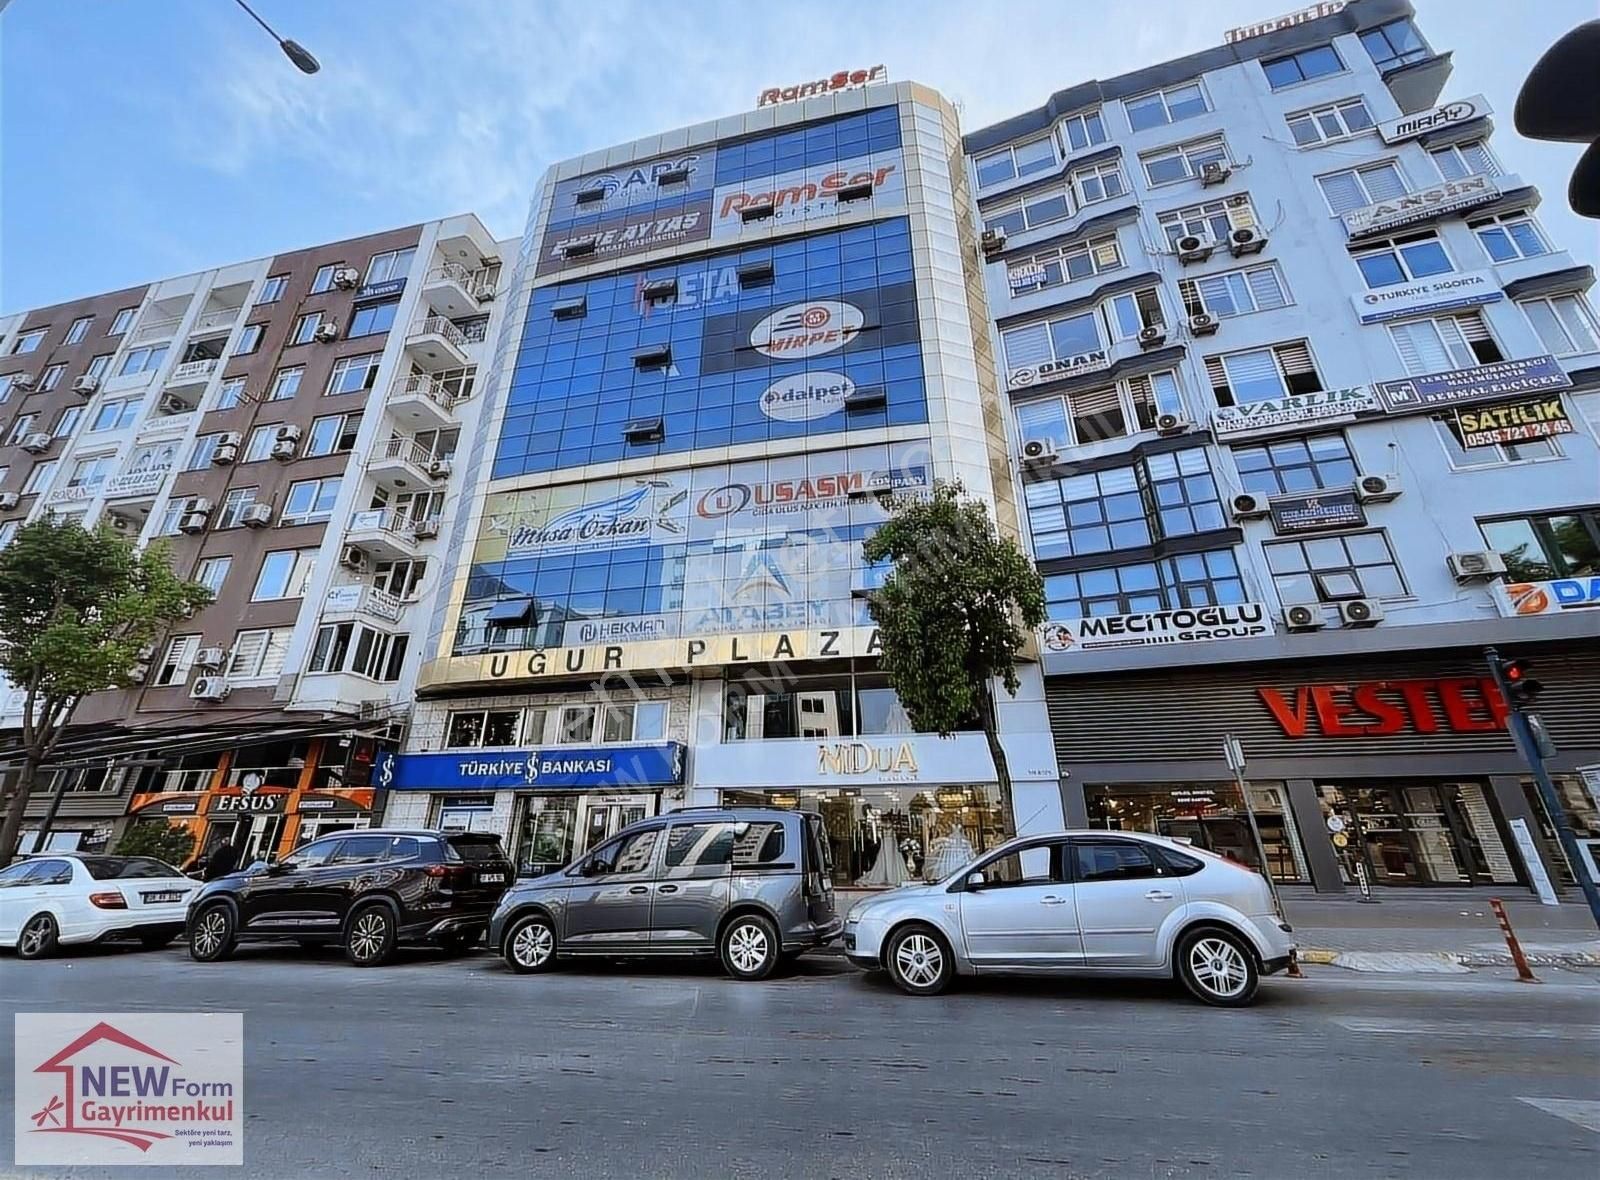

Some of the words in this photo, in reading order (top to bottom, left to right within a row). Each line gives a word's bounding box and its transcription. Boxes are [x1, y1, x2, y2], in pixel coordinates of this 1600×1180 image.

[759, 64, 884, 107] RamSer
[1038, 351, 1106, 375] ONAN
[1238, 386, 1366, 417] VARLIK
[1461, 400, 1565, 432] SATILIK
[1468, 430, 1501, 447] 0535
[1506, 427, 1530, 441] 721
[1532, 423, 1550, 437] 24
[1555, 419, 1573, 434] 45
[579, 514, 648, 540] Özkan
[1178, 626, 1266, 642] GROUP
[490, 645, 624, 678] UĞUR
[686, 630, 885, 664] PLAZA
[459, 759, 524, 776] TÜRKİYE
[541, 759, 611, 774] BANKASI
